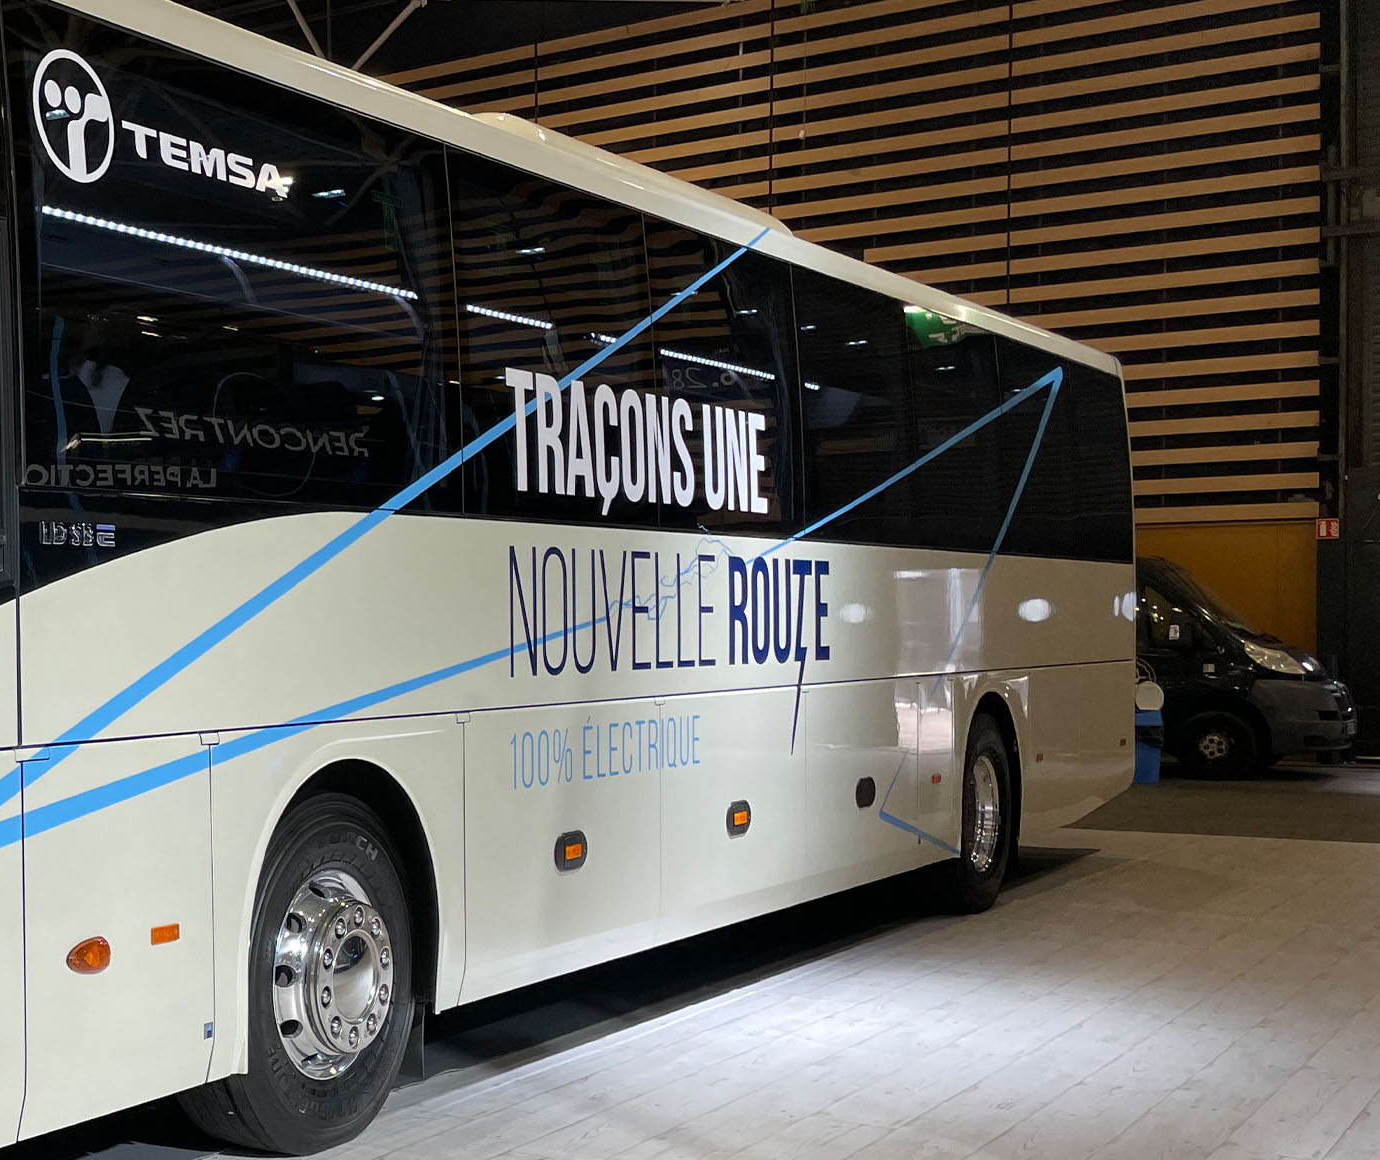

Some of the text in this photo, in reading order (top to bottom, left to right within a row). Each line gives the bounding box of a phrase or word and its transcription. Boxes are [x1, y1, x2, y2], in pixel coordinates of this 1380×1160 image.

[121, 119, 289, 198] TEMSA
[505, 367, 769, 516] TRAÇONS UNE
[509, 546, 831, 755] NOUVELLE ROUTE
[510, 715, 701, 790] 100% ÉLECTRIQUE
